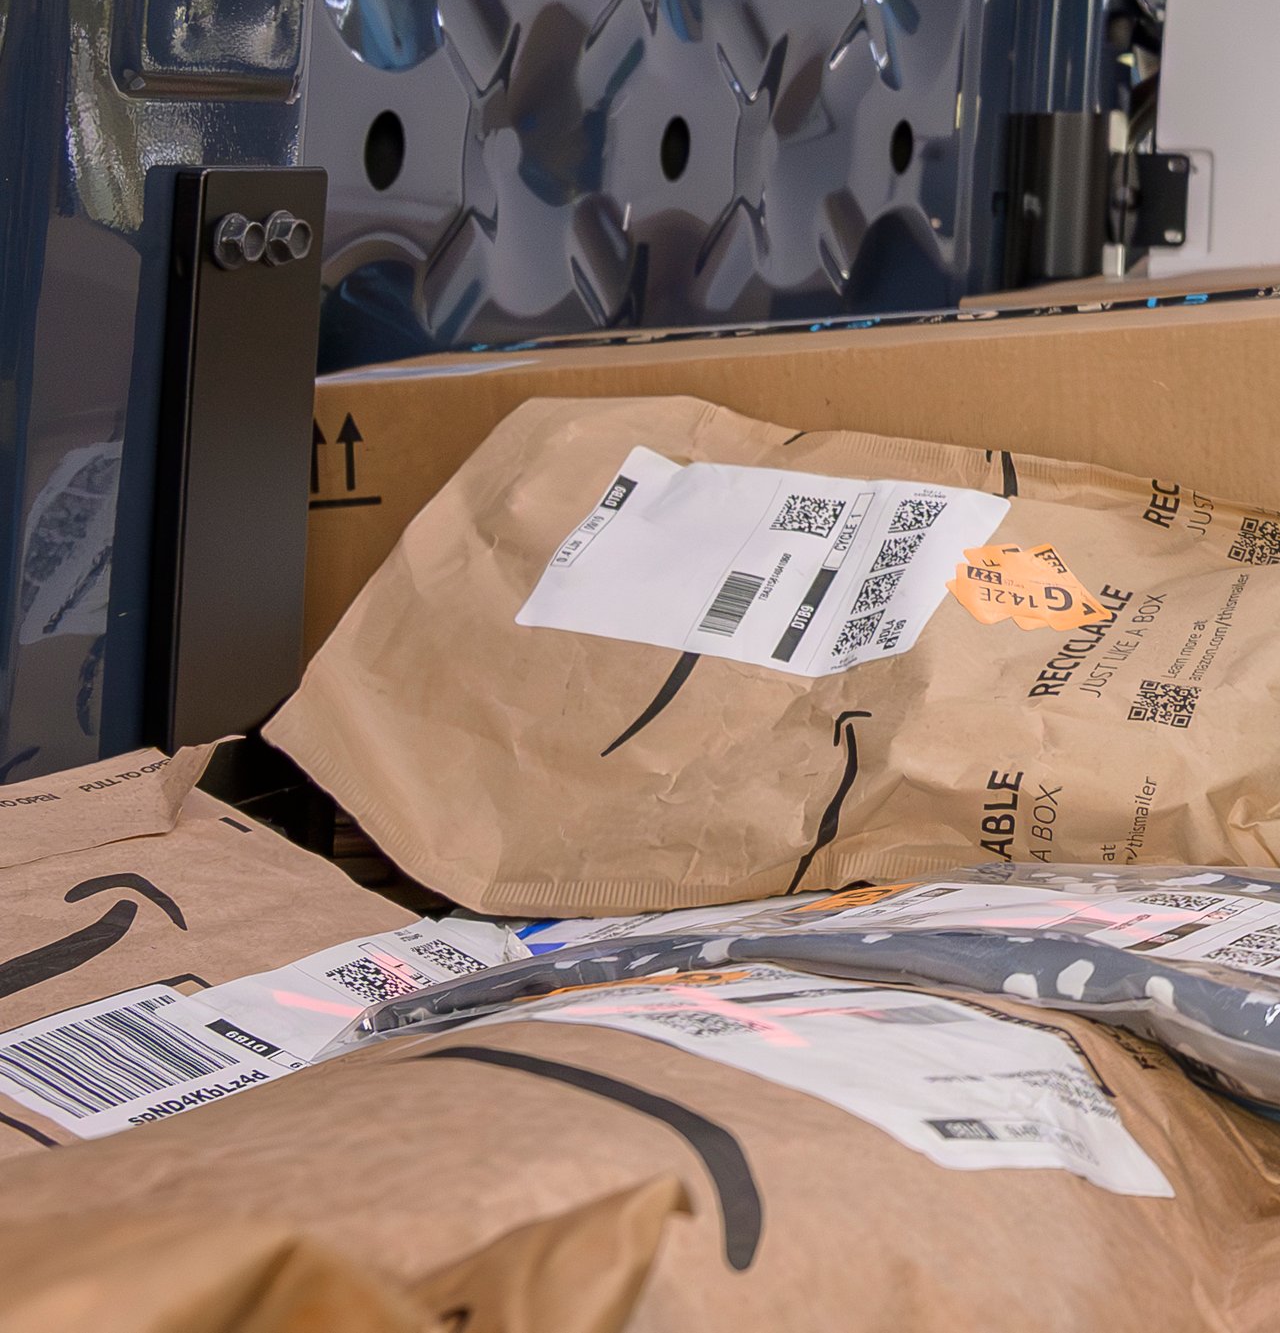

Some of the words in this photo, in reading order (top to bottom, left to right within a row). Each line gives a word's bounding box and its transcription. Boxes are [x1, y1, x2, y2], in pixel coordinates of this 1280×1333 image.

[1187, 491, 1214, 535] JUST
[833, 522, 858, 552] CYCLE
[969, 567, 998, 584] 327
[1044, 586, 1074, 612] G
[1132, 593, 1167, 623] BOX
[790, 605, 815, 631] DTB9
[1125, 627, 1144, 637] A
[1028, 584, 1134, 698] RECYCLALE
[1108, 640, 1140, 662] LIKE
[1161, 657, 1190, 678] Learn
[1181, 633, 1202, 656] more
[1080, 662, 1118, 698] JUST
[79, 779, 122, 793] PULL
[115, 771, 142, 781] TO
[140, 758, 172, 774] OPE
[16, 793, 62, 805] OPEN
[1032, 783, 1063, 842] BOX
[980, 770, 1025, 861] ABLE
[1030, 849, 1052, 863] A
[1101, 843, 1116, 862] at
[225, 1030, 269, 1054] DTB9
